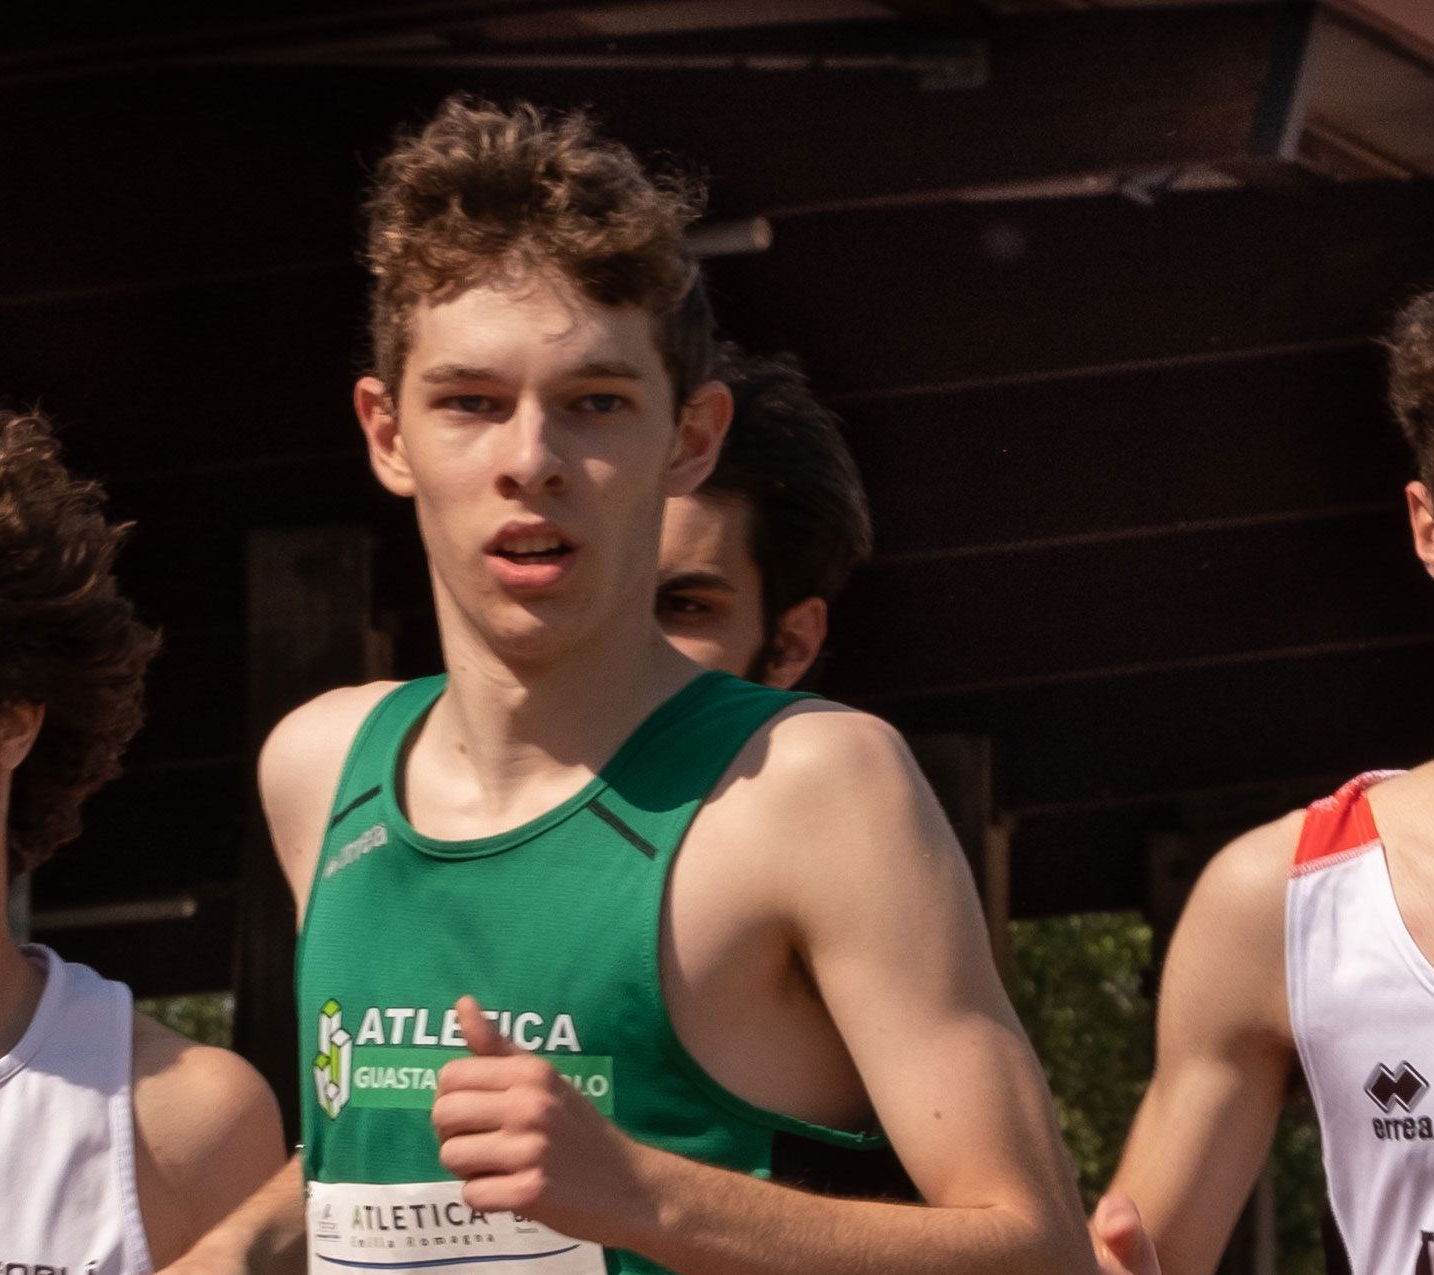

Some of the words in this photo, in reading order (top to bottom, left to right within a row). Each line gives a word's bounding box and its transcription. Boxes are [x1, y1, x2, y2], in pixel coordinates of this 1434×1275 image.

[355, 1006, 583, 1053] ATLEICA
[353, 1066, 439, 1091] GUASTA
[351, 1201, 489, 1231] ATLETICA
